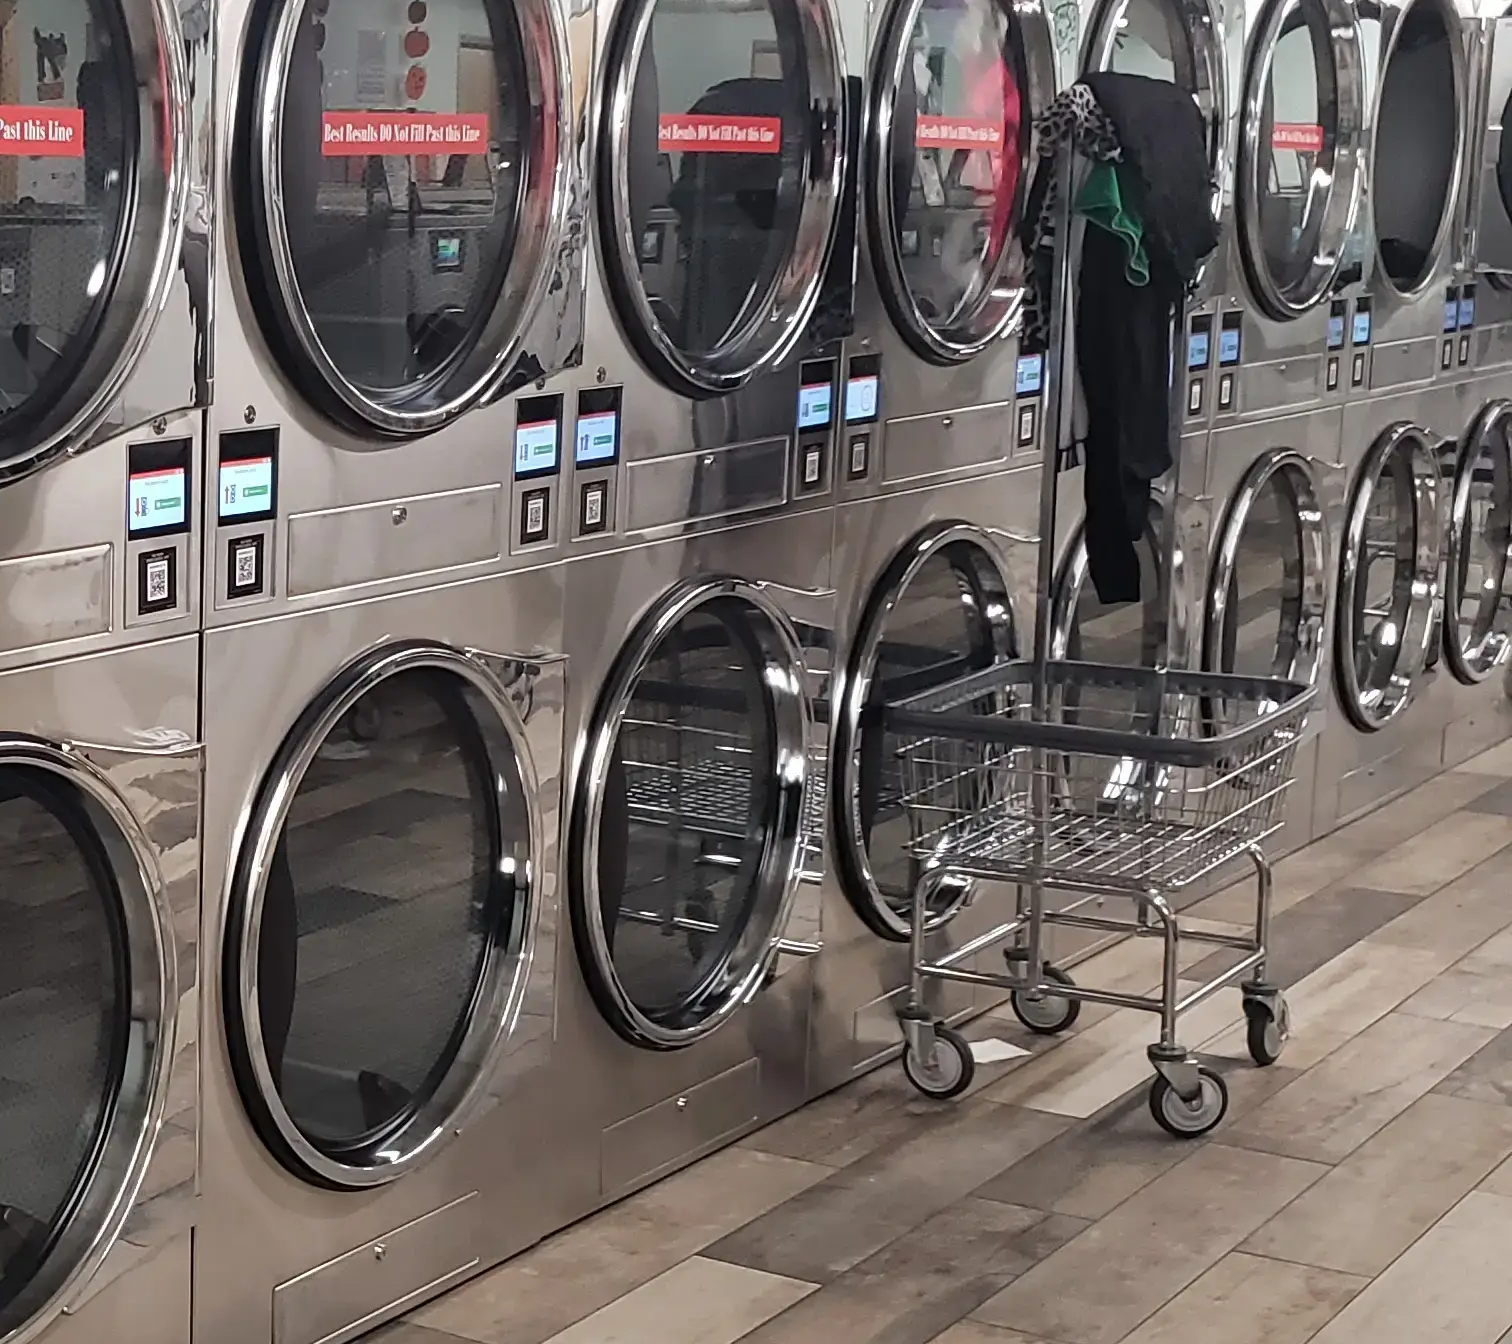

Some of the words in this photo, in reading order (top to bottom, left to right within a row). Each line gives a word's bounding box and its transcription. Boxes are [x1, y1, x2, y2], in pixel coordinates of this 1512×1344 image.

[24, 119, 46, 141] this
[48, 119, 73, 142] Line
[324, 124, 344, 142] Best
[410, 124, 425, 142] Fill
[426, 125, 444, 142] Past
[445, 125, 460, 142] this
[462, 125, 481, 142] Line
